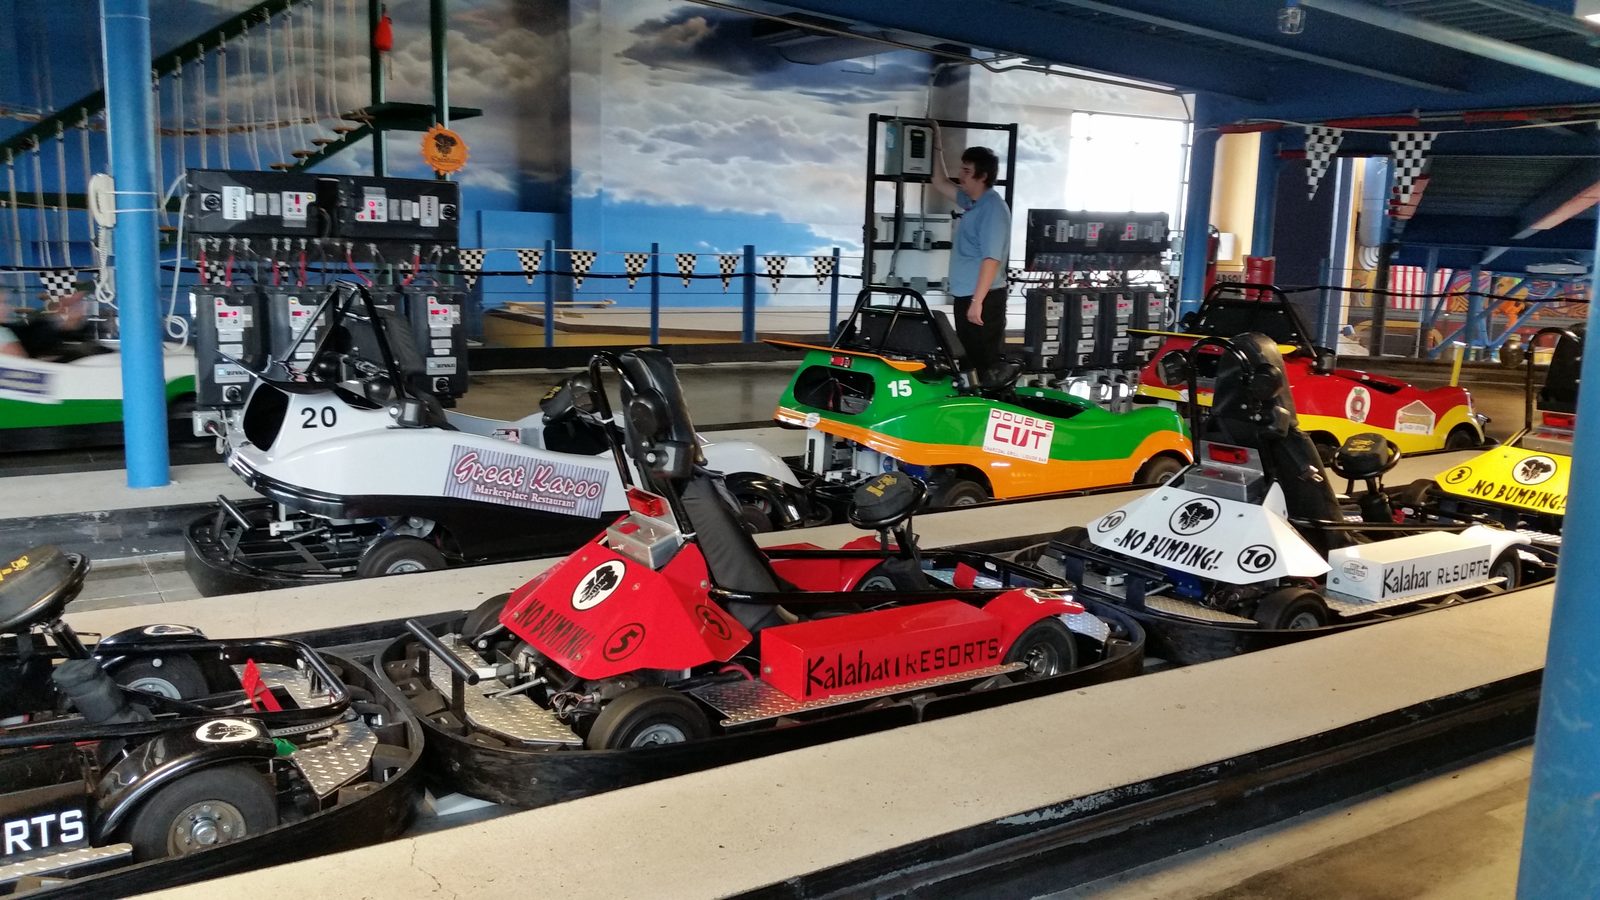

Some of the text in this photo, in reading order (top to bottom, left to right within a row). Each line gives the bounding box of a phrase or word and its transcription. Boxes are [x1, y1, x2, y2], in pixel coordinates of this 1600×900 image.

[887, 379, 913, 398] 15
[301, 406, 337, 428] 20
[991, 409, 1054, 431] DOUBLE
[993, 422, 1047, 450] CUT
[454, 452, 601, 499] Great Karoo
[1451, 469, 1466, 481] 3
[474, 484, 576, 508] Marketplace Restaurant
[1471, 479, 1568, 510] NO BUMPING!
[1100, 515, 1122, 528] 10
[1117, 528, 1223, 571] NO BUMPING!
[1242, 549, 1271, 569] 10
[1437, 559, 1490, 585] RESORTS
[514, 598, 545, 629] NO
[609, 628, 639, 654] 5
[905, 638, 999, 676] RESORTS
